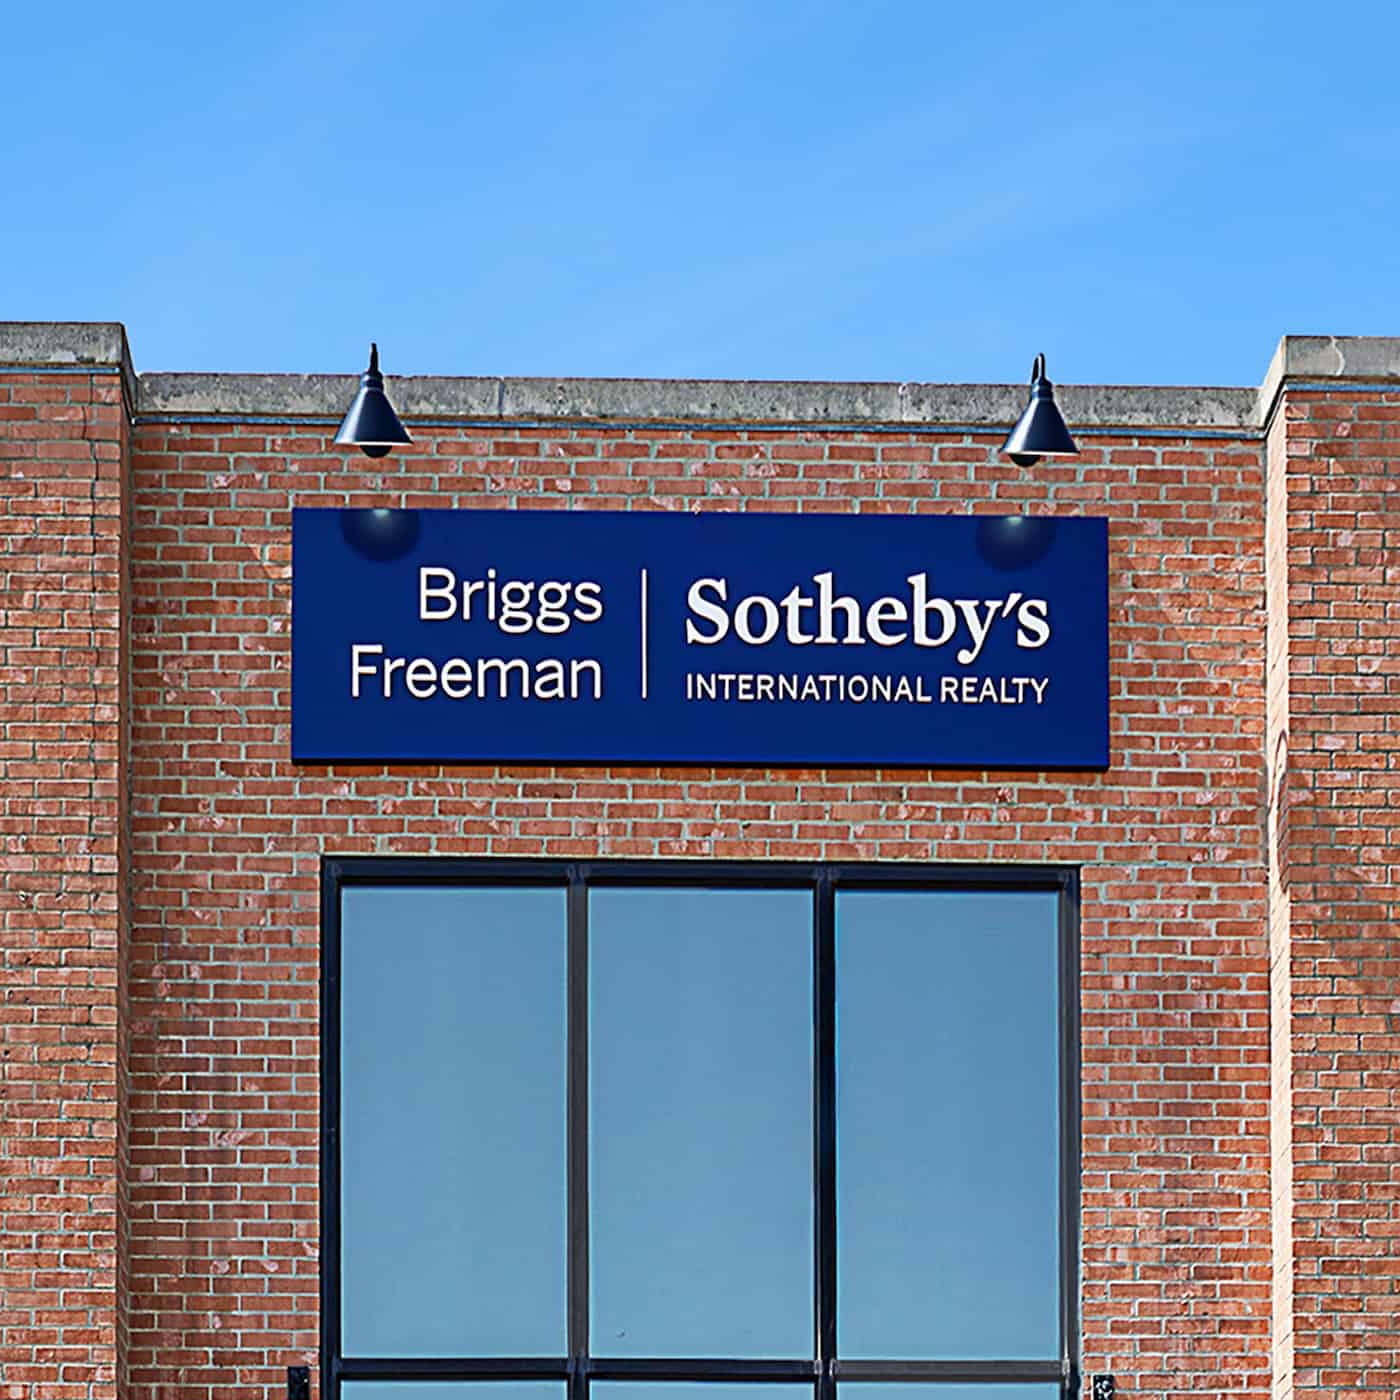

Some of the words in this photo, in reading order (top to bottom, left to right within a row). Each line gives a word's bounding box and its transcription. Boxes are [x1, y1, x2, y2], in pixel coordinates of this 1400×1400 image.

[419, 567, 603, 633] Briggs
[685, 571, 1050, 665] Sotheby's
[350, 644, 602, 699] Freeman
[686, 673, 932, 703] INTERNATIONAL
[939, 676, 1049, 704] REALTY
